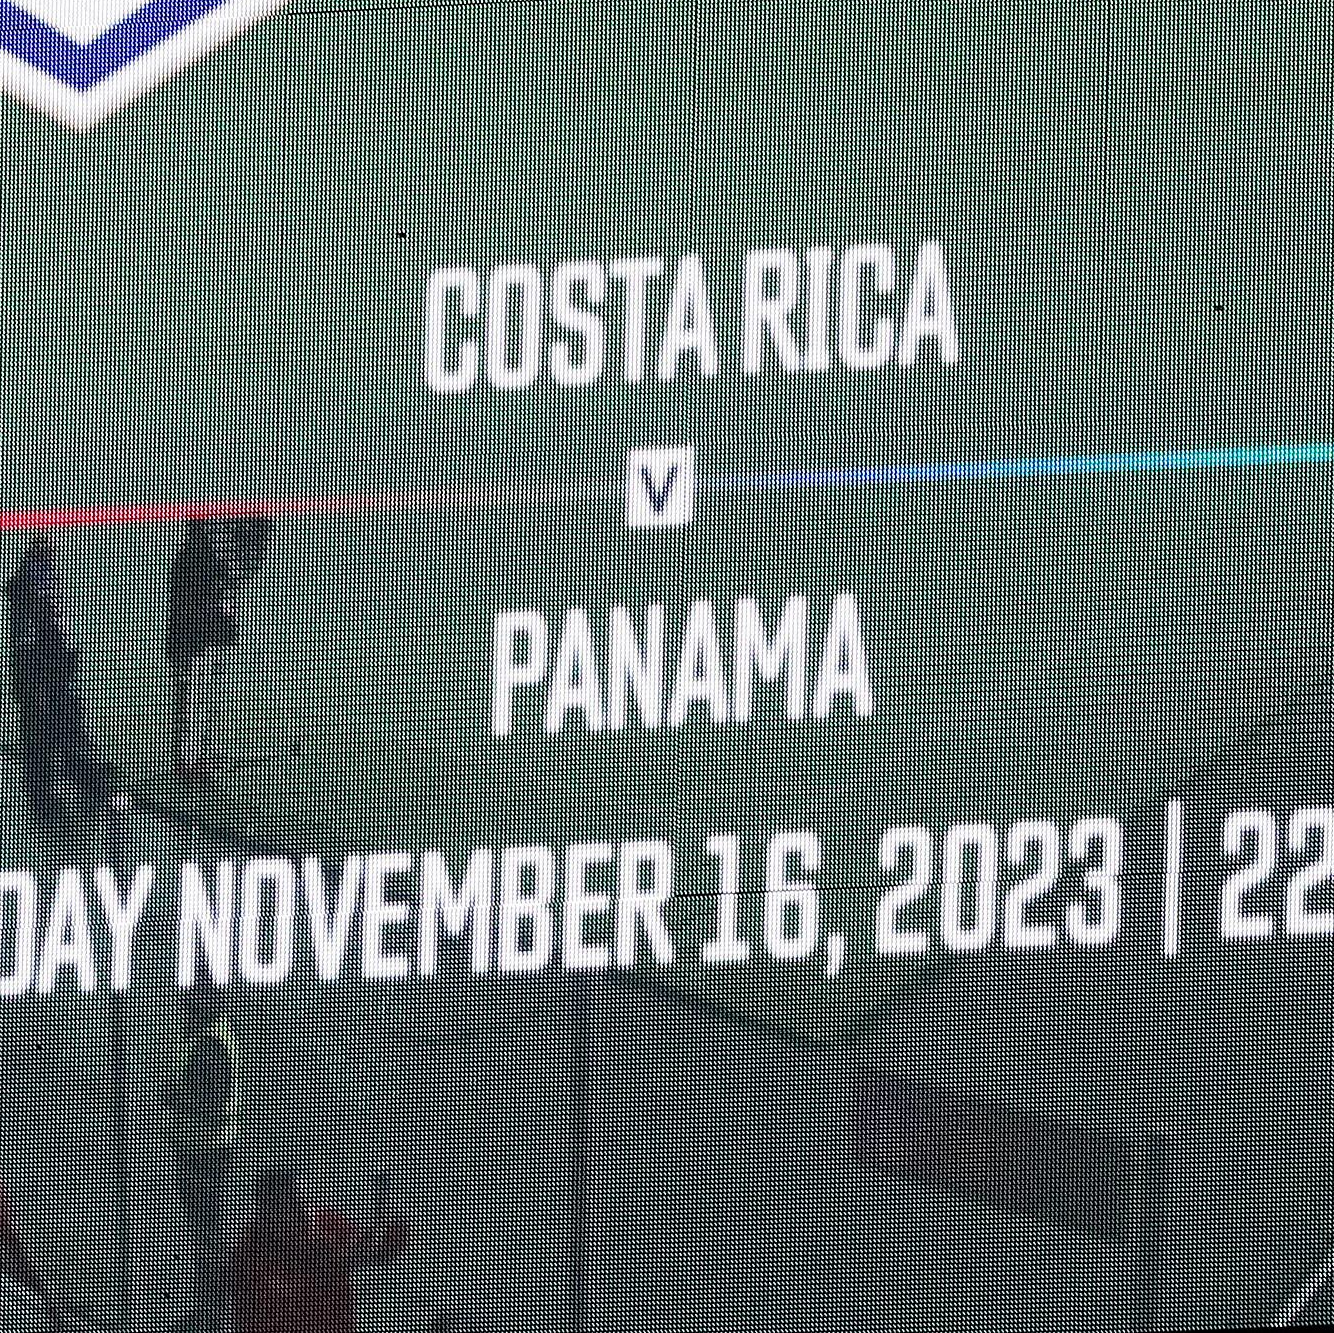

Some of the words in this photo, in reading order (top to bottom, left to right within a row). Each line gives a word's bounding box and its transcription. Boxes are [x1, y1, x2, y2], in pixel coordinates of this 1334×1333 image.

[424, 253, 719, 395] COSTA
[742, 240, 959, 375] RICA
[641, 466, 679, 516] V
[491, 592, 874, 737] PANAMA
[176, 838, 676, 990] NOVEMBER
[702, 830, 846, 980] 16,
[876, 818, 1123, 954] 2023
